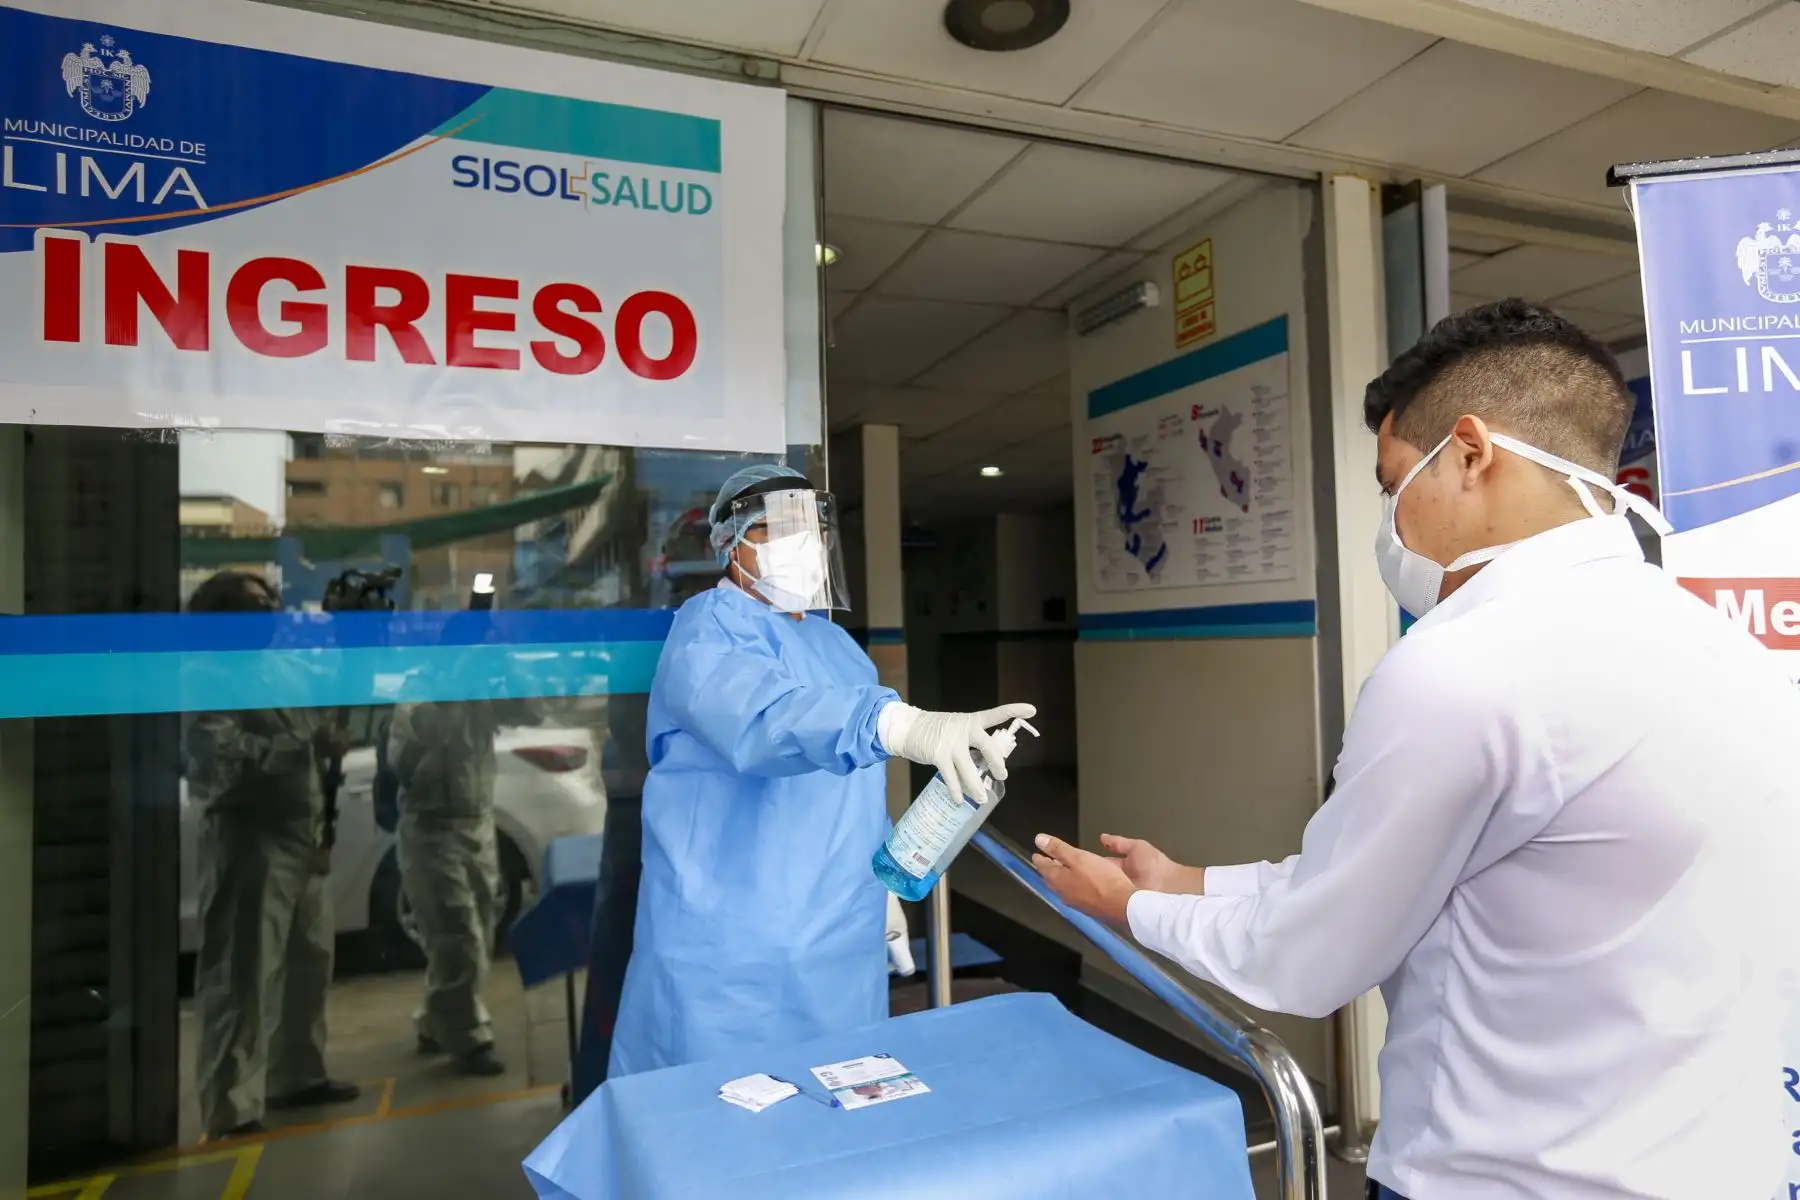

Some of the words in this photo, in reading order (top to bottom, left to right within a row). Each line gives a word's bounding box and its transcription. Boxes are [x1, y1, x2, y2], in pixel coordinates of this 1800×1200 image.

[4, 118, 174, 151] MUNICIPALIDAD
[180, 141, 206, 156] DE
[3, 145, 209, 210] LIMA
[451, 155, 581, 201] SISOL
[591, 172, 713, 215] SALUD
[43, 235, 697, 381] INGRESO
[1715, 588, 1800, 636] Me
